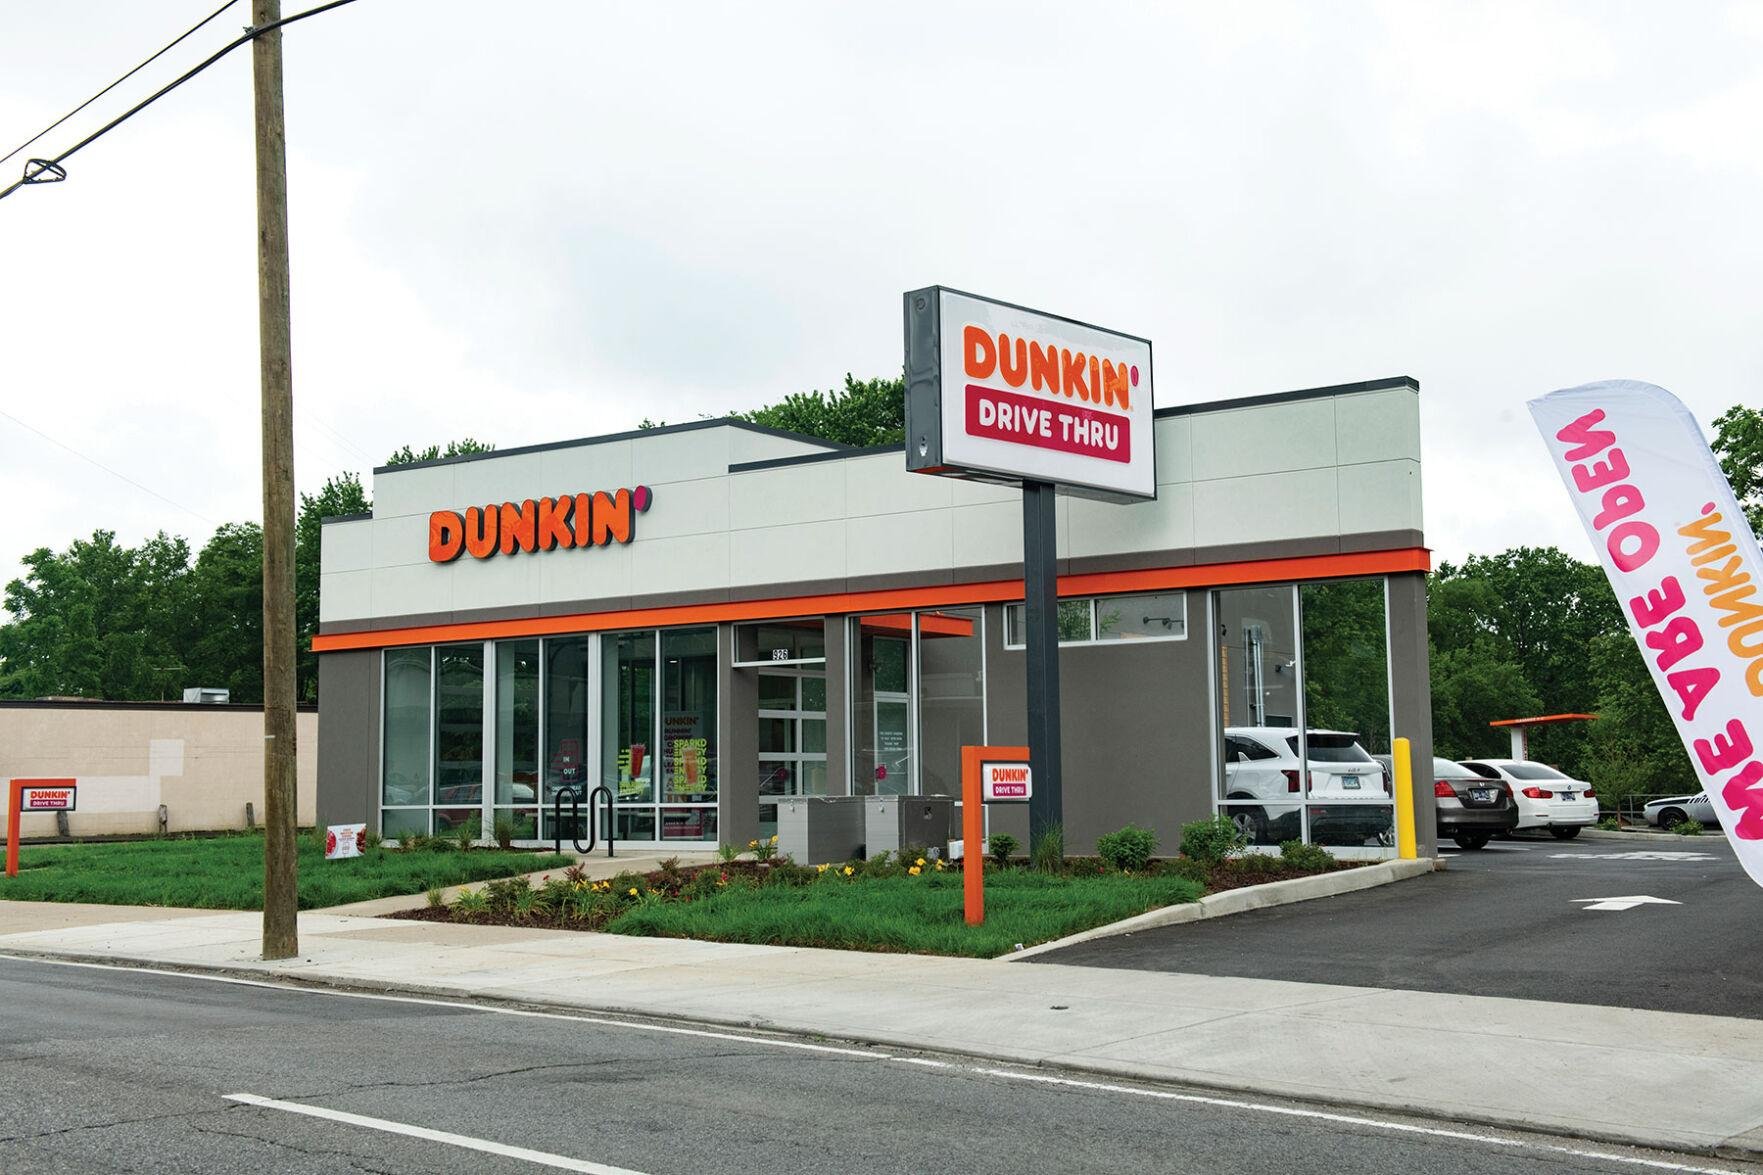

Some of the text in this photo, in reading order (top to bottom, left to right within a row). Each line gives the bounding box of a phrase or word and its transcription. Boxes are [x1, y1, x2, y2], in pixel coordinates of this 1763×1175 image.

[963, 325, 1139, 410] DUNKIN'
[979, 398, 1119, 450] DRIVE THRU
[429, 485, 653, 564] DUNKIN'
[773, 649, 788, 660] 926
[992, 768, 1029, 782] DUNKIN'
[995, 786, 1024, 794] DRIVE THRU
